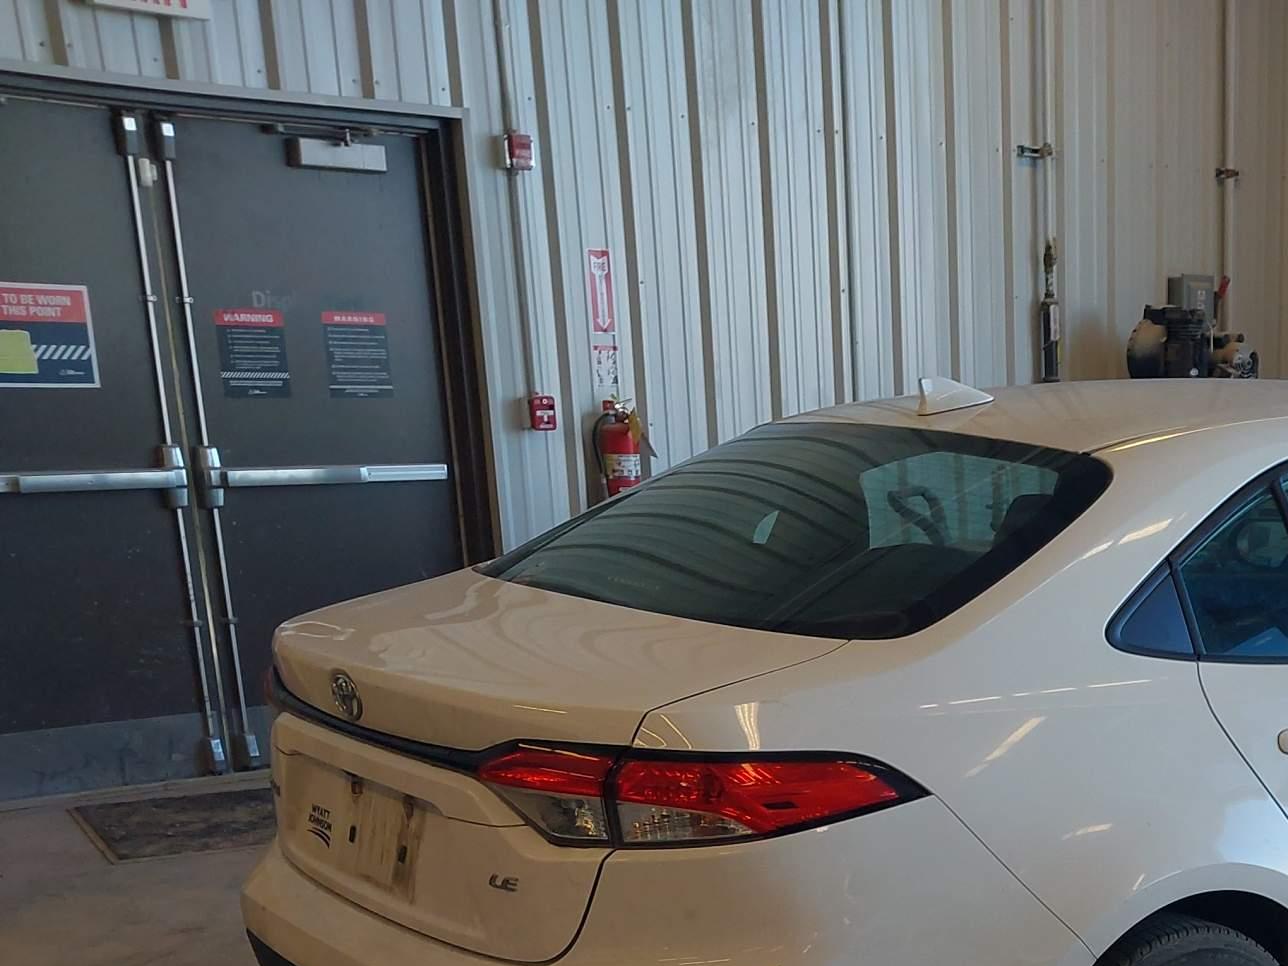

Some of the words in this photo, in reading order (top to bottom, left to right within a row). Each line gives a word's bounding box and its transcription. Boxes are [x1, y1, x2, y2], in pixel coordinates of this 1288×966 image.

[2, 293, 18, 305] TO
[20, 294, 35, 305] BE
[36, 294, 71, 306] WORN
[2, 305, 27, 316] THIS
[29, 306, 62, 317] POINT
[223, 313, 274, 323] WARNING
[489, 873, 519, 893] LE
